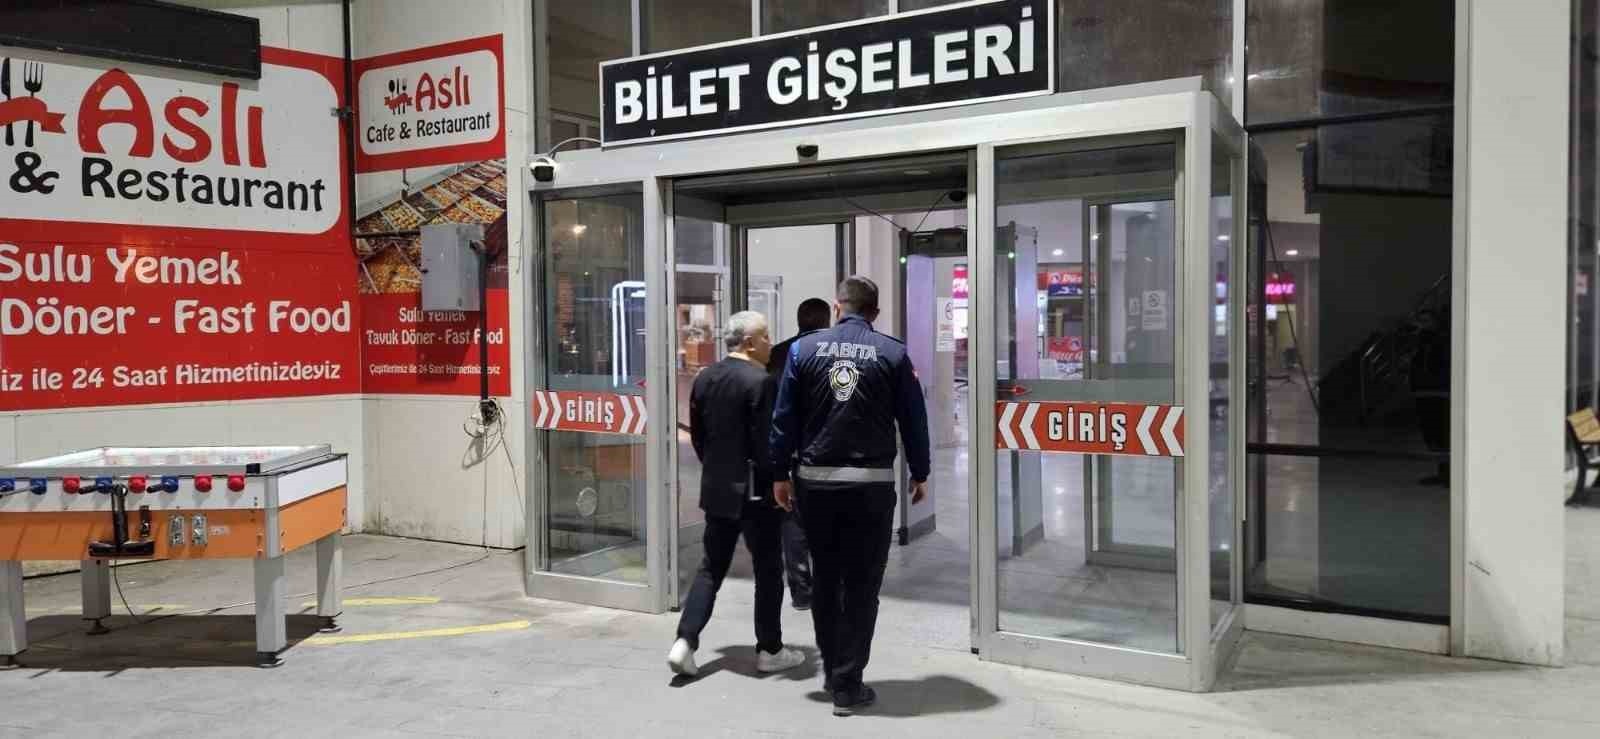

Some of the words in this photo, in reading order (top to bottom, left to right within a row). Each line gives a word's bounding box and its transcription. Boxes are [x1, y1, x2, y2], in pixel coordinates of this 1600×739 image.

[615, 64, 750, 125] BİLET
[767, 6, 1035, 110] GİŞELERİ
[415, 66, 470, 112] Aslı
[77, 67, 267, 168] Aslı
[367, 123, 395, 143] Cafe
[400, 122, 412, 139] &
[417, 112, 491, 137] Restaurant
[9, 151, 60, 194] &
[82, 157, 325, 212] Restaurant
[0, 243, 92, 283] Sulu
[106, 247, 242, 286] Yemek
[0, 297, 136, 336] Döner
[174, 299, 257, 335] Fast
[269, 300, 350, 334] Food
[366, 328, 399, 345] Tavuk
[401, 328, 435, 345] Döner
[445, 328, 471, 345] Fast
[474, 327, 504, 345] Fod
[815, 341, 878, 362] ZABITA
[32, 367, 64, 391] ile
[71, 367, 105, 390] 24
[112, 365, 168, 388] Saat
[175, 359, 342, 385] Hizmetinizdeyiz
[565, 395, 614, 430] GİRİŞ
[1048, 406, 1127, 451] GİRİŞ
